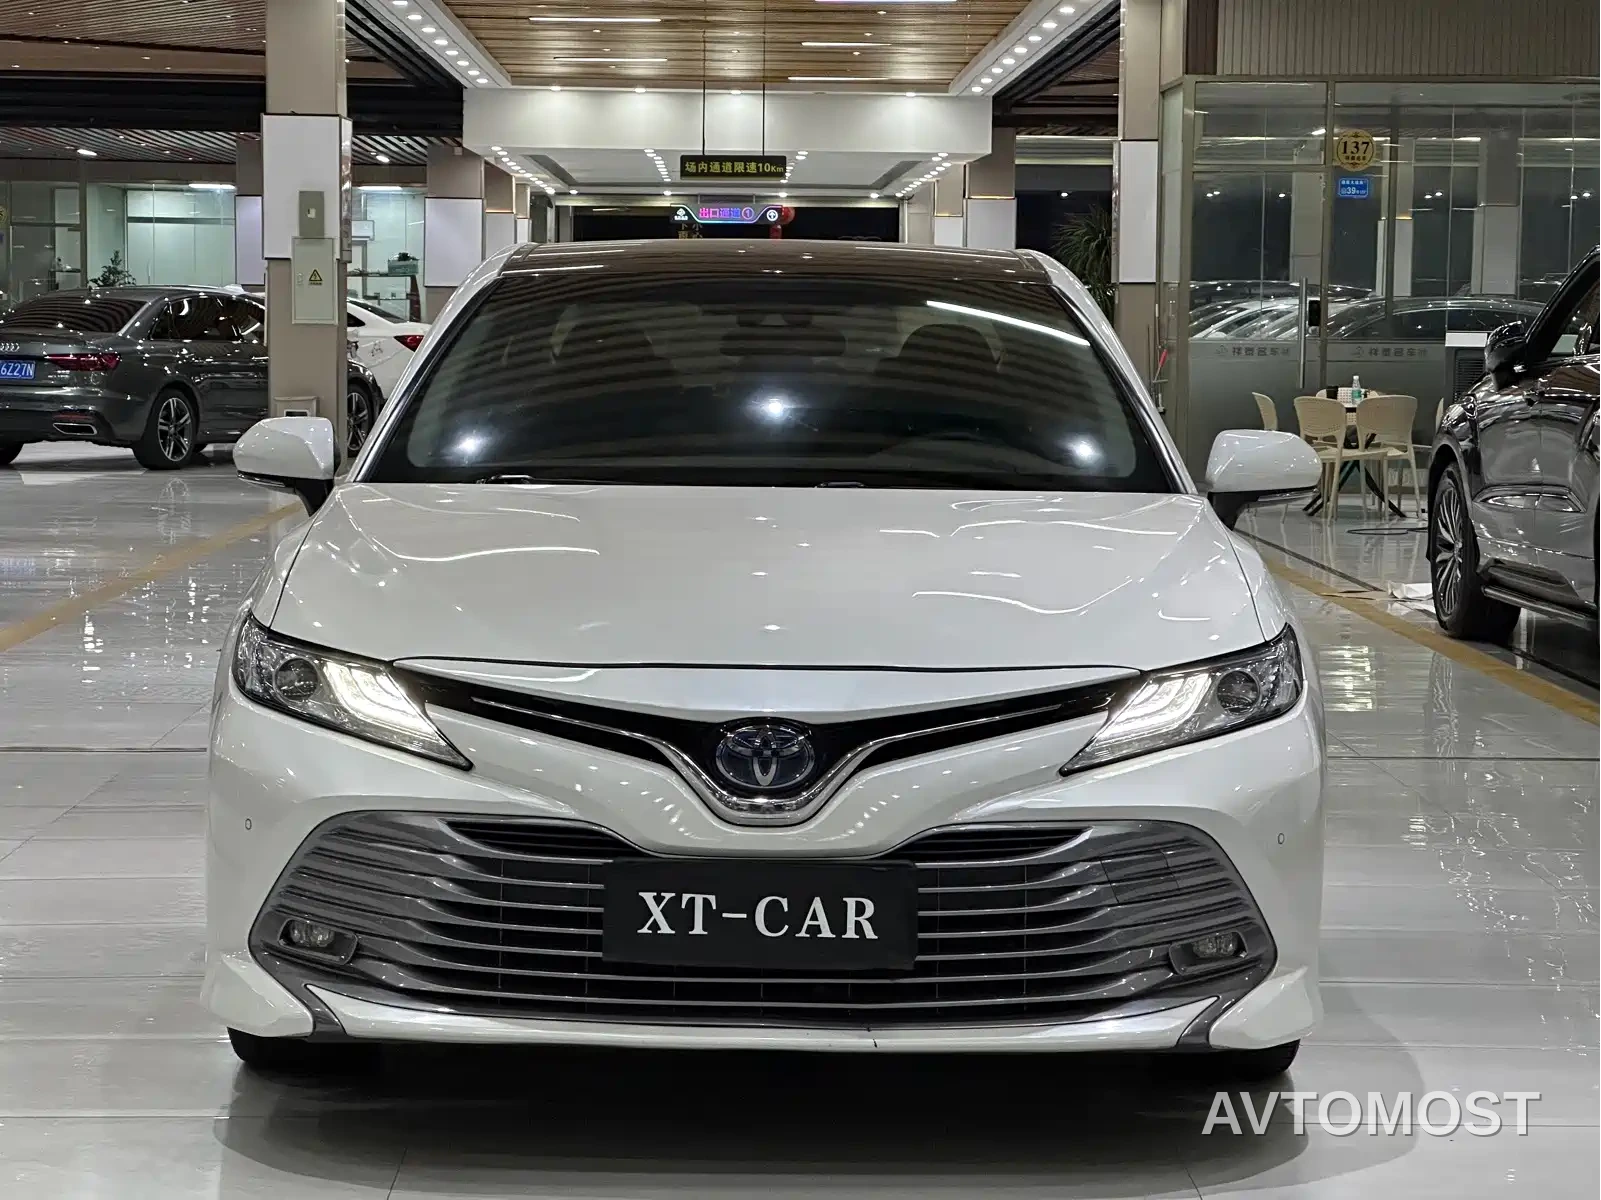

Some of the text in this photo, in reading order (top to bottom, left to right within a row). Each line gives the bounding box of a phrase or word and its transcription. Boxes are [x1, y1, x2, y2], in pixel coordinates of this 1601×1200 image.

[1342, 141, 1370, 154] 137
[0, 362, 34, 376] 6Z27N
[637, 891, 879, 939] XT-CAR
